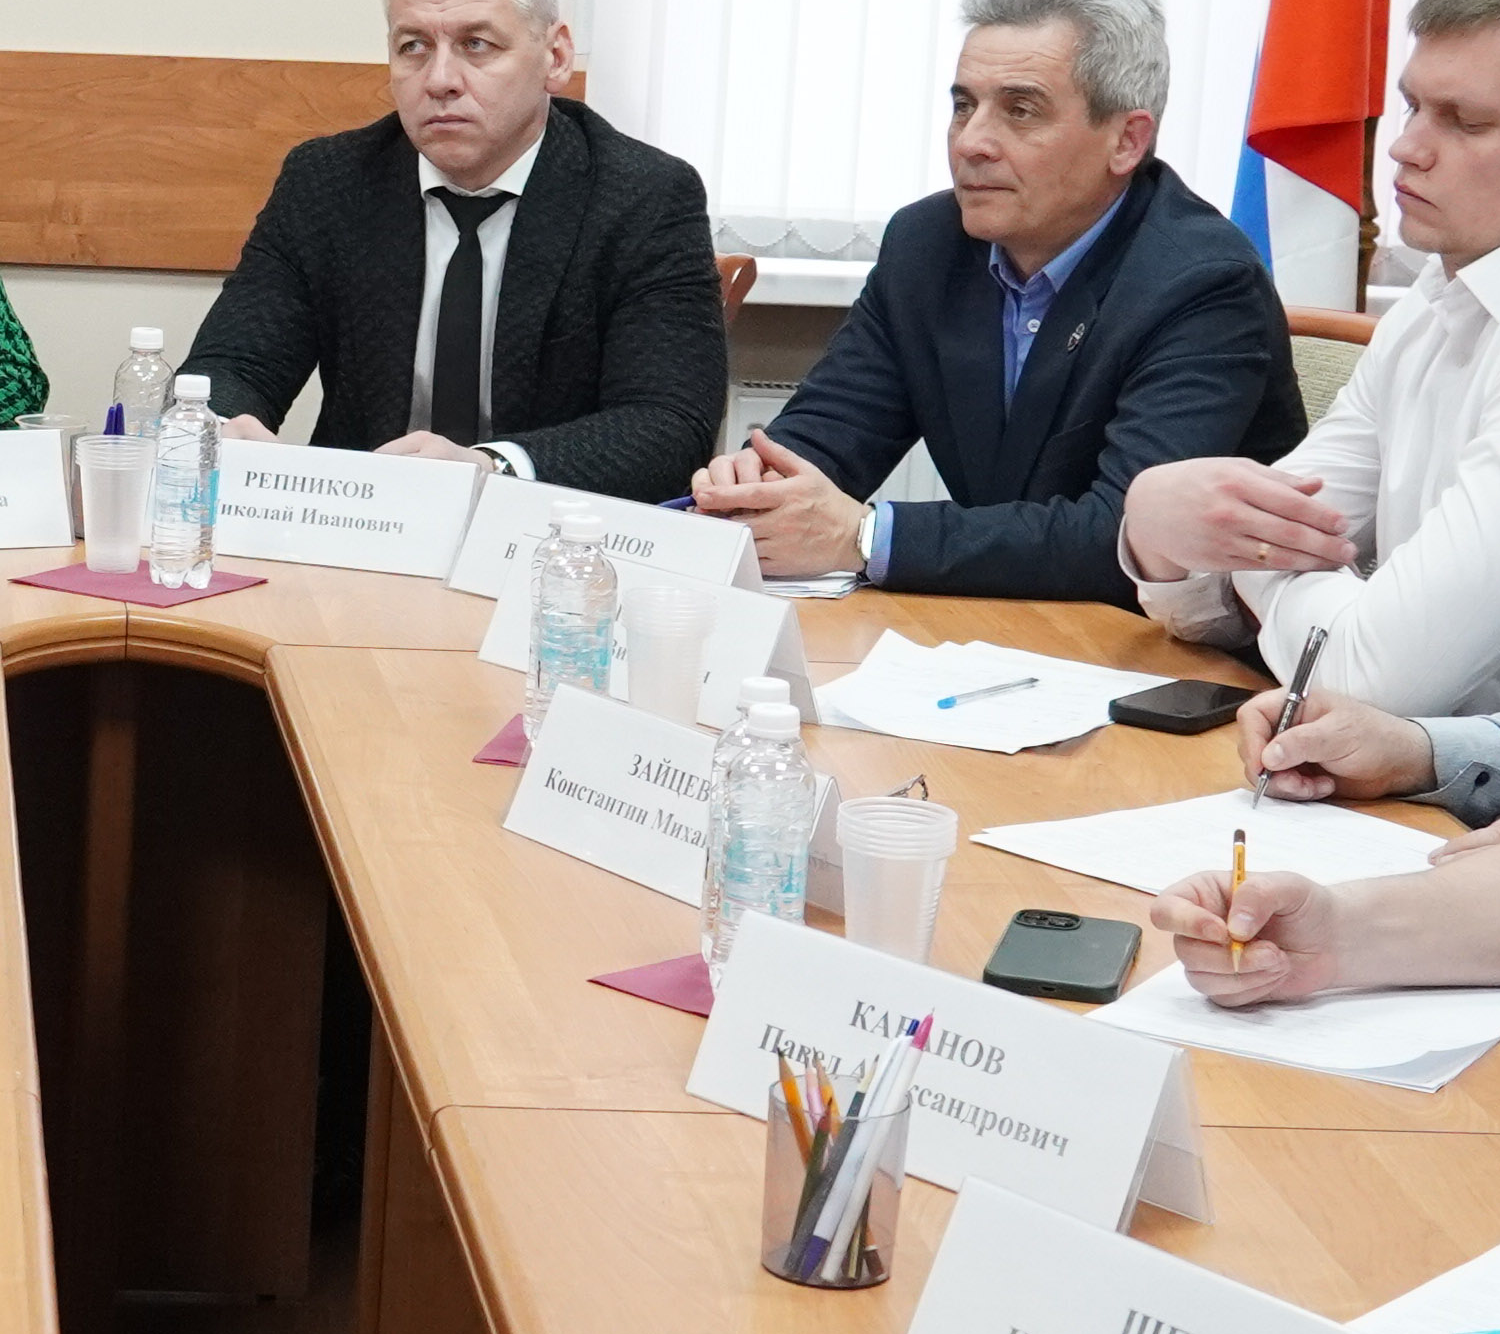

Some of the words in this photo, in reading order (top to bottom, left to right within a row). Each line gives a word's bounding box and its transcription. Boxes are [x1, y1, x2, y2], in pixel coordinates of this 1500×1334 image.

[244, 471, 375, 499] РЕПНИКОВ
[218, 500, 294, 523] иколай
[300, 507, 404, 534] Иванович
[544, 767, 649, 826] Константин
[627, 753, 711, 802] ЗАЙЦЕВ
